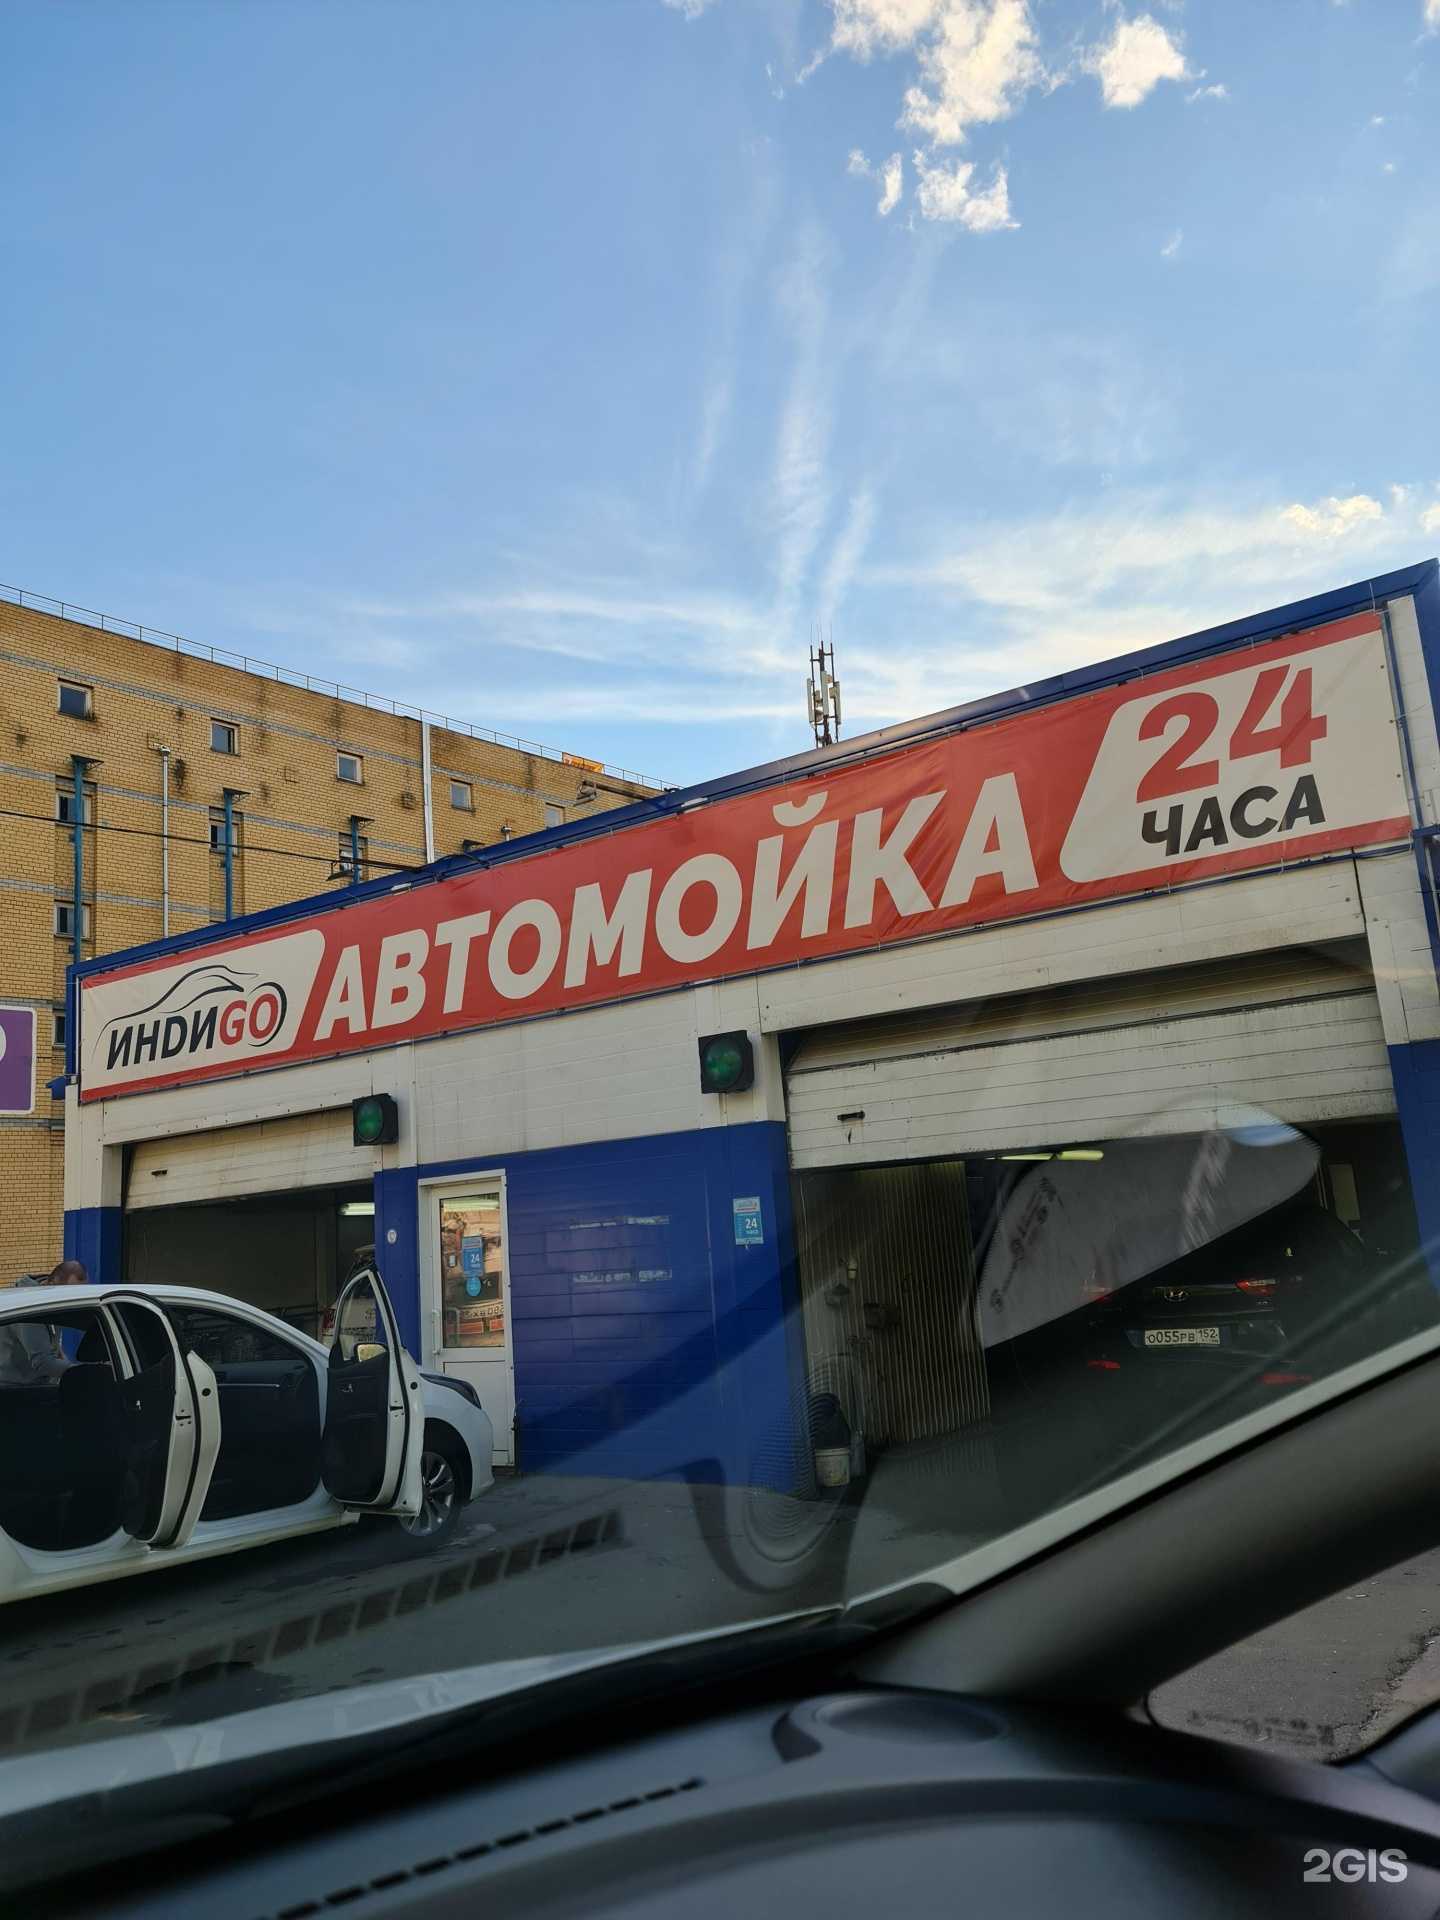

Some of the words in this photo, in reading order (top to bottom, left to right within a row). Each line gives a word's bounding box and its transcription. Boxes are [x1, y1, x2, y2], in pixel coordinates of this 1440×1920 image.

[1136, 664, 1327, 804] 24
[1141, 773, 1327, 857] ЧАСА
[313, 771, 1040, 1042] АВТОМОЙКА
[745, 1218, 758, 1229] 24
[471, 1253, 480, 1264] 24
[1199, 1328, 1216, 1339] 152
